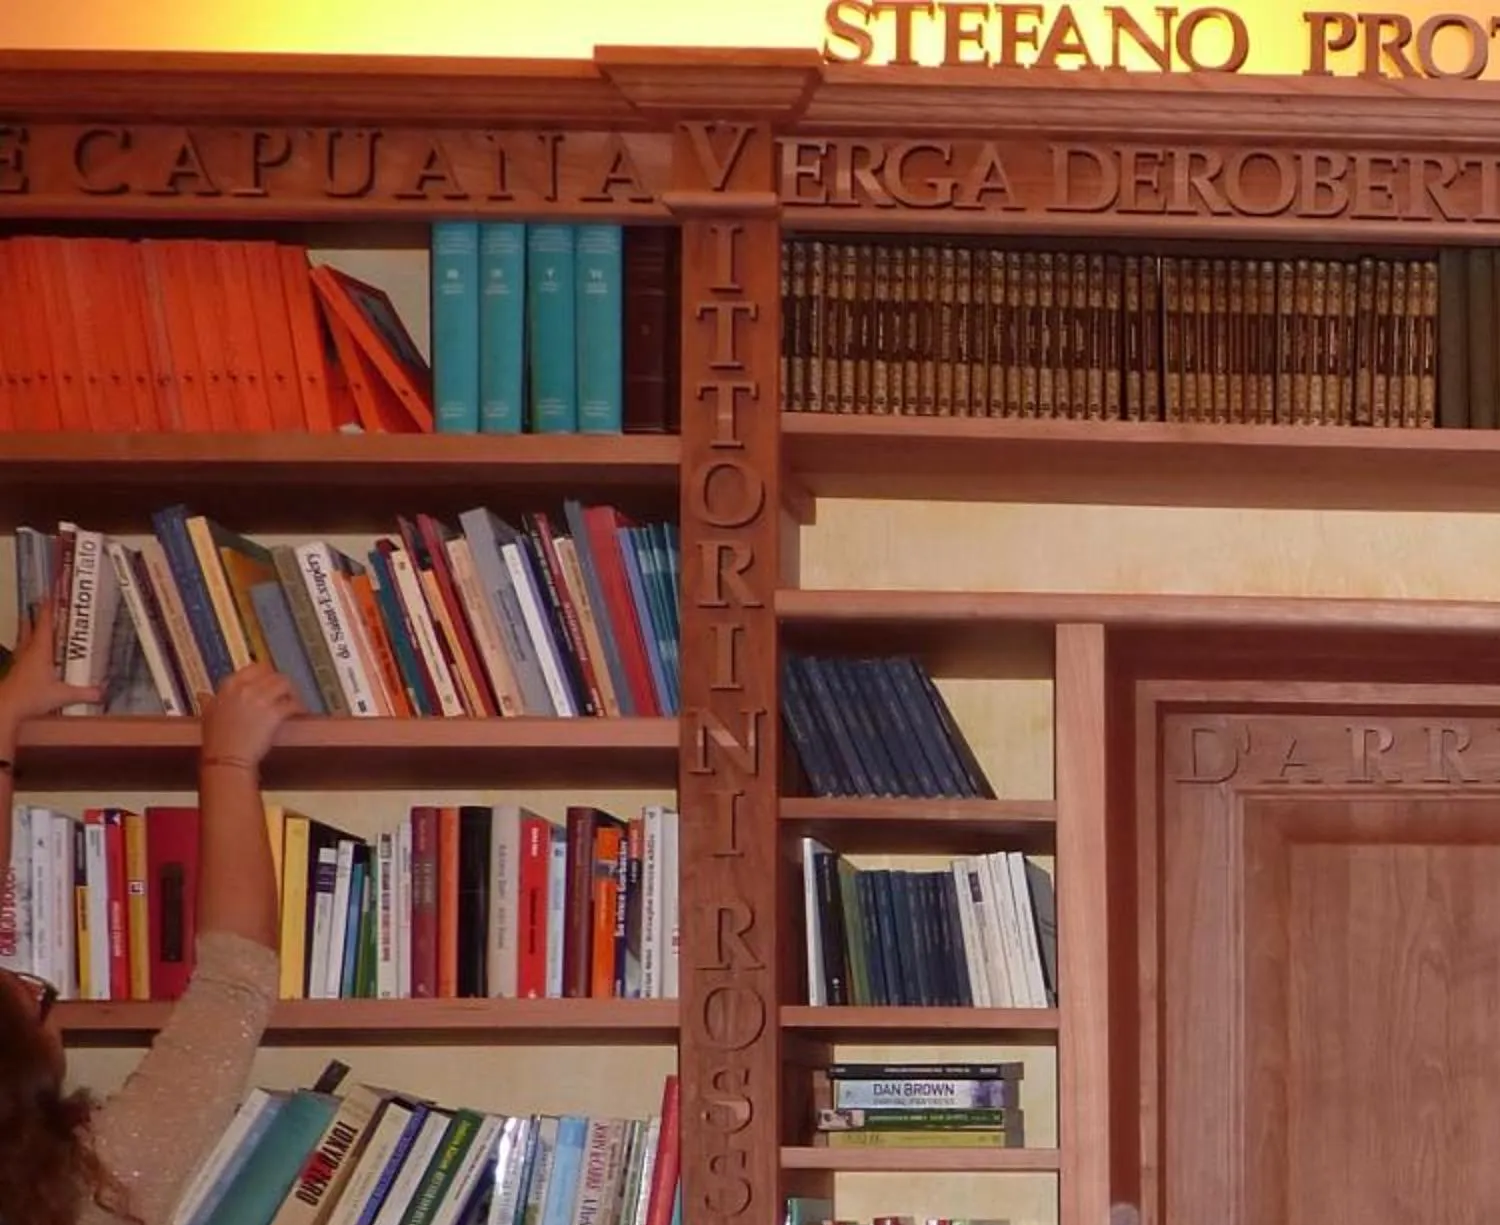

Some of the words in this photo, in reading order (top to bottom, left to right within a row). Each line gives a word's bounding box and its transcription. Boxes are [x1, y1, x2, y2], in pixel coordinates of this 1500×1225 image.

[824, 0, 1250, 74] STEFANO
[72, 124, 656, 204] CAPUANA
[677, 119, 769, 863] VITTORINI
[66, 578, 97, 662] Wharton
[873, 1082, 903, 1098] DAN
[904, 1082, 956, 1098] BROWN
